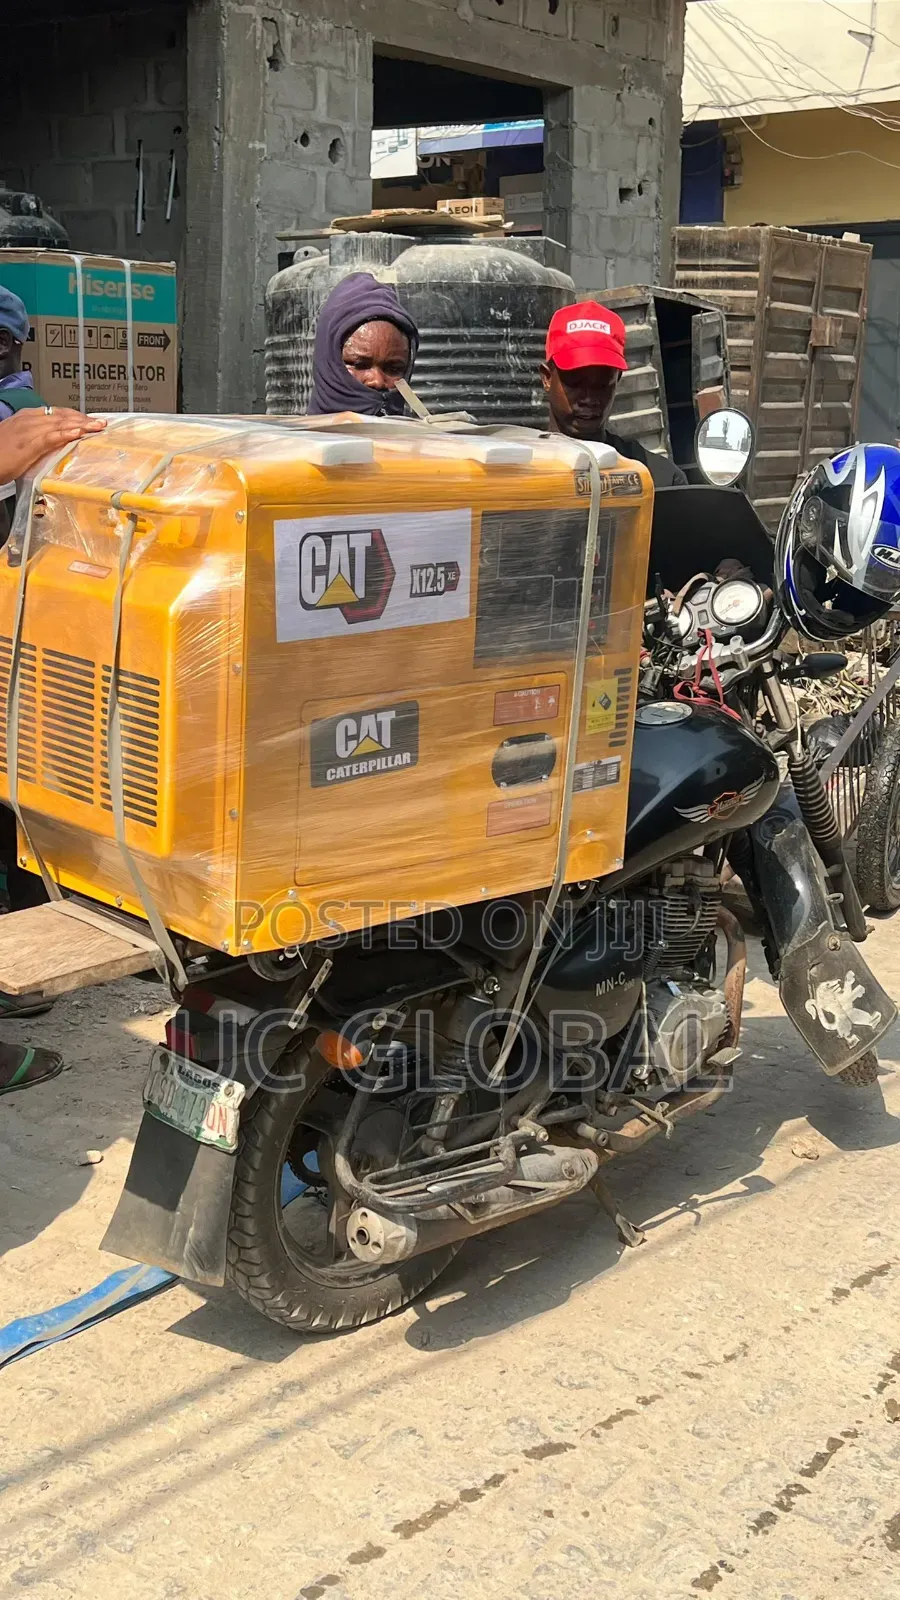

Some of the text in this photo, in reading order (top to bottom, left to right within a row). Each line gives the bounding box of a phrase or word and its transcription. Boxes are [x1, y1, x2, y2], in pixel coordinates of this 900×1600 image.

[68, 272, 155, 301] Hisense
[138, 335, 166, 346] FRONT
[569, 321, 609, 332] DJACK
[577, 476, 609, 492] Silnt
[300, 531, 373, 605] CAT
[411, 566, 445, 594] X12.5
[335, 710, 396, 759] CAT
[326, 752, 411, 781] CATERPILLAR
[595, 971, 626, 997] MN-C
[176, 1065, 221, 1093] LAGOS
